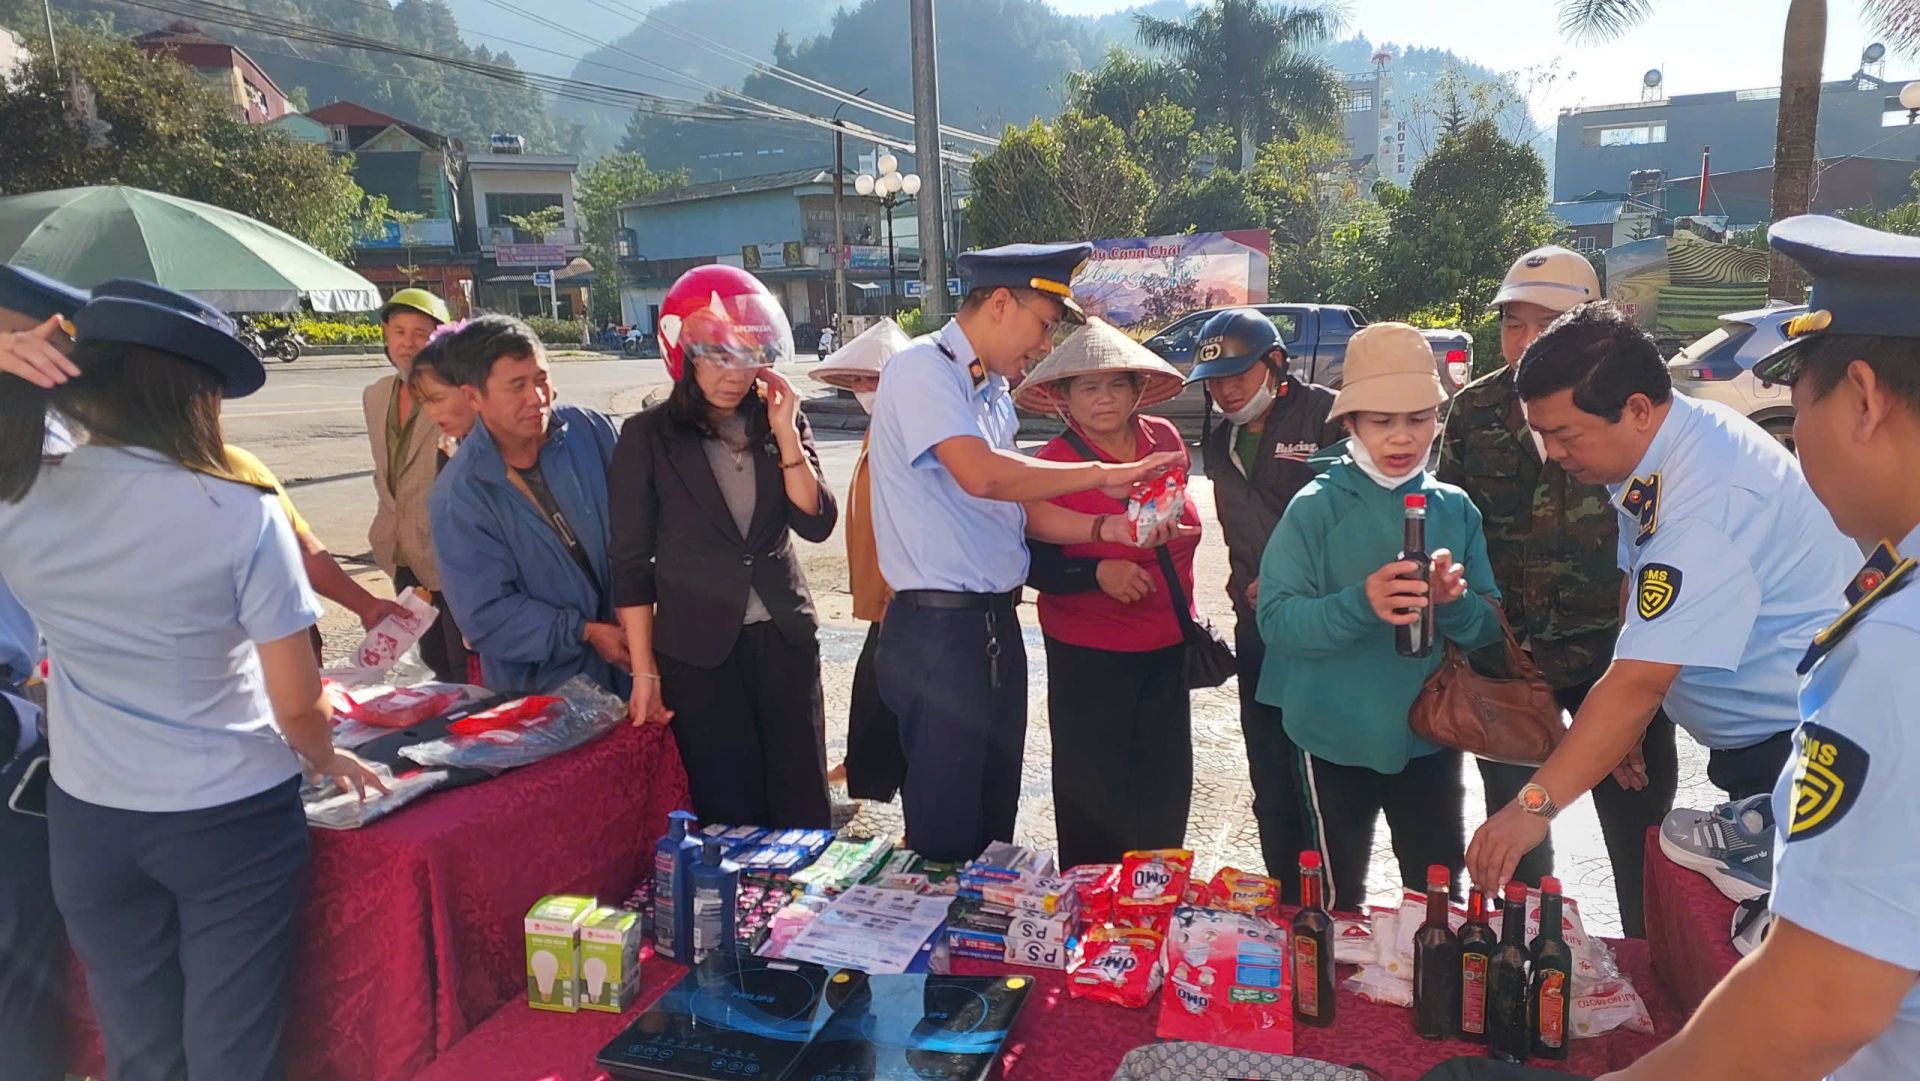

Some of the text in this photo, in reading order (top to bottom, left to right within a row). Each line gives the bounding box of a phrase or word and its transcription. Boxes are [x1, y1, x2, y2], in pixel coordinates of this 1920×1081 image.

[1397, 121, 1406, 174] HOTEL
[1109, 246, 1145, 262] Cang
[733, 325, 772, 333] HONDA
[1133, 870, 1170, 887] OMO
[1021, 923, 1048, 940] PS
[1027, 945, 1058, 963] PS
[1176, 987, 1209, 1008] OMO
